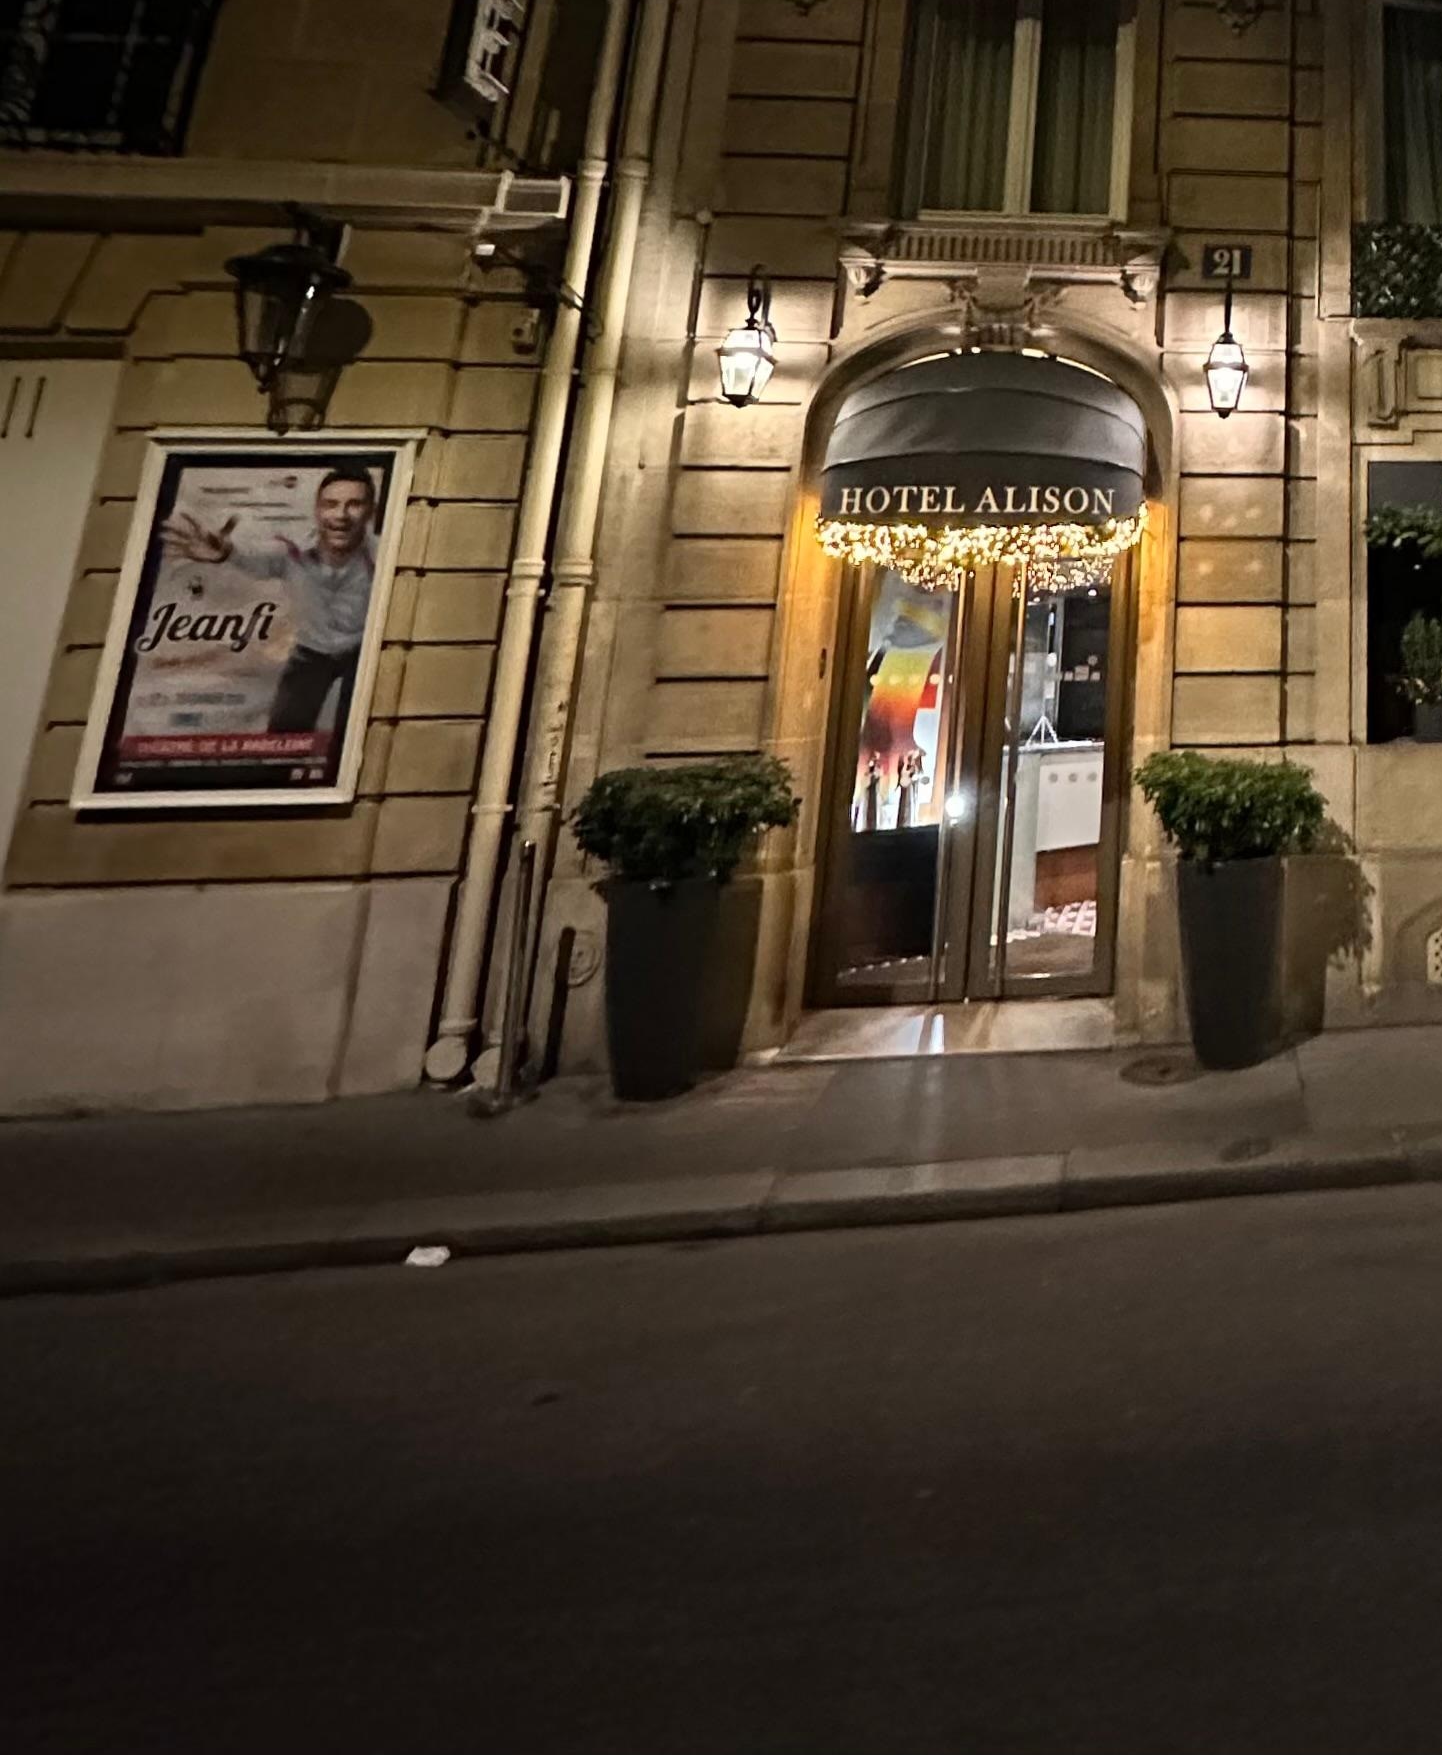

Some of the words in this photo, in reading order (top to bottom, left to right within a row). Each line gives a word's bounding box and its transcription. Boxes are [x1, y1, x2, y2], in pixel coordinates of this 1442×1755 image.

[1213, 249, 1241, 274] 21
[838, 486, 966, 515] HOTEL
[974, 486, 1117, 516] ALISON
[137, 602, 280, 652] Jeanfi
